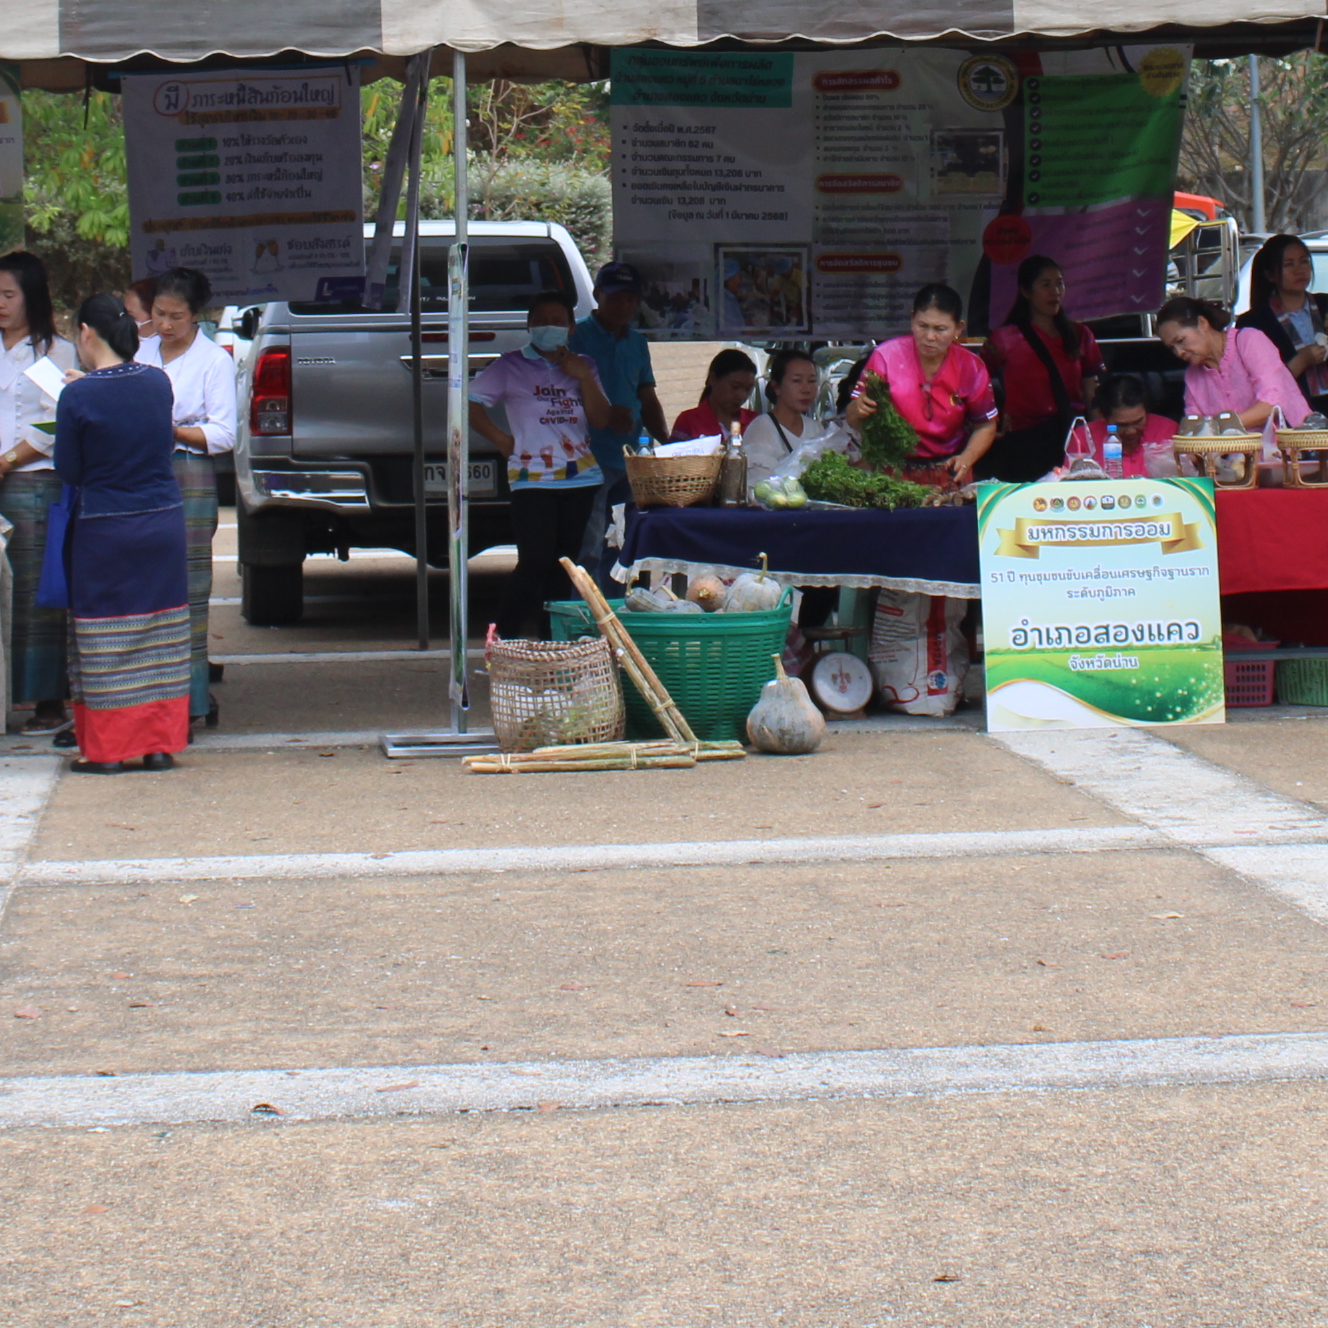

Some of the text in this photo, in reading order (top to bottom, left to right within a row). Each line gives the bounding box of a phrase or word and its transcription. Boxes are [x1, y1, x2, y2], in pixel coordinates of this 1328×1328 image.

[164, 85, 180, 110] มี
[297, 356, 336, 365] TOYOTA
[551, 397, 583, 409] Fight
[1027, 522, 1171, 541] มหกรรมการออม
[990, 565, 1210, 587] 51 ปี ทุนชุมชนขับเคลื่อนเศรษฐกิจฐานราก
[1066, 586, 1136, 602] ระดับภูมิภาค
[1011, 618, 1200, 648] อำเภอสองแคว
[1069, 654, 1139, 671] จังหวัดน่าน
